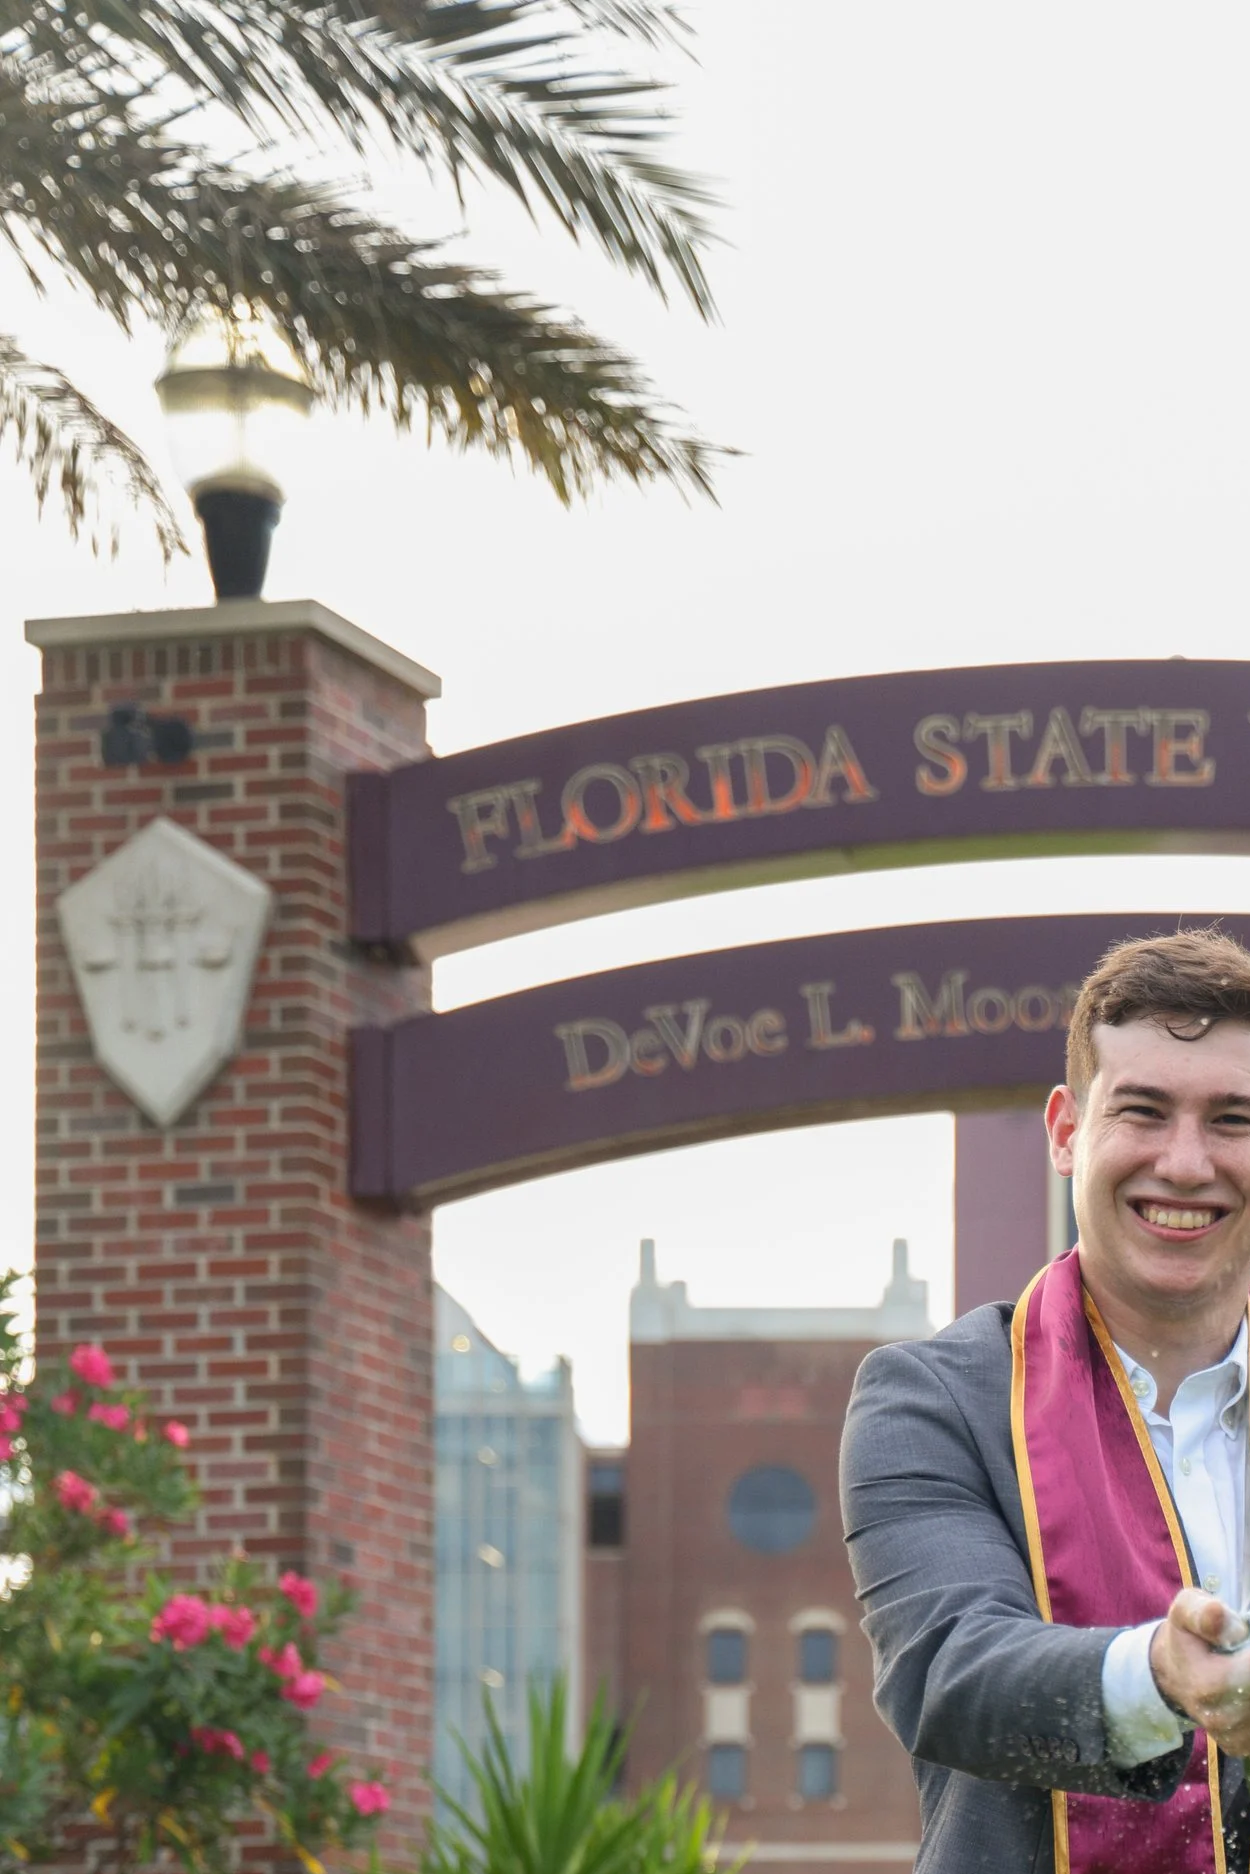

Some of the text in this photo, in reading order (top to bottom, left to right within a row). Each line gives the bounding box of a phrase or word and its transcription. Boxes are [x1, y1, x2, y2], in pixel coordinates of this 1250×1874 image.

[447, 724, 878, 873] FLORIDA
[914, 706, 1217, 796] STATE
[555, 998, 790, 1093] DeVoe
[802, 980, 877, 1049] L.
